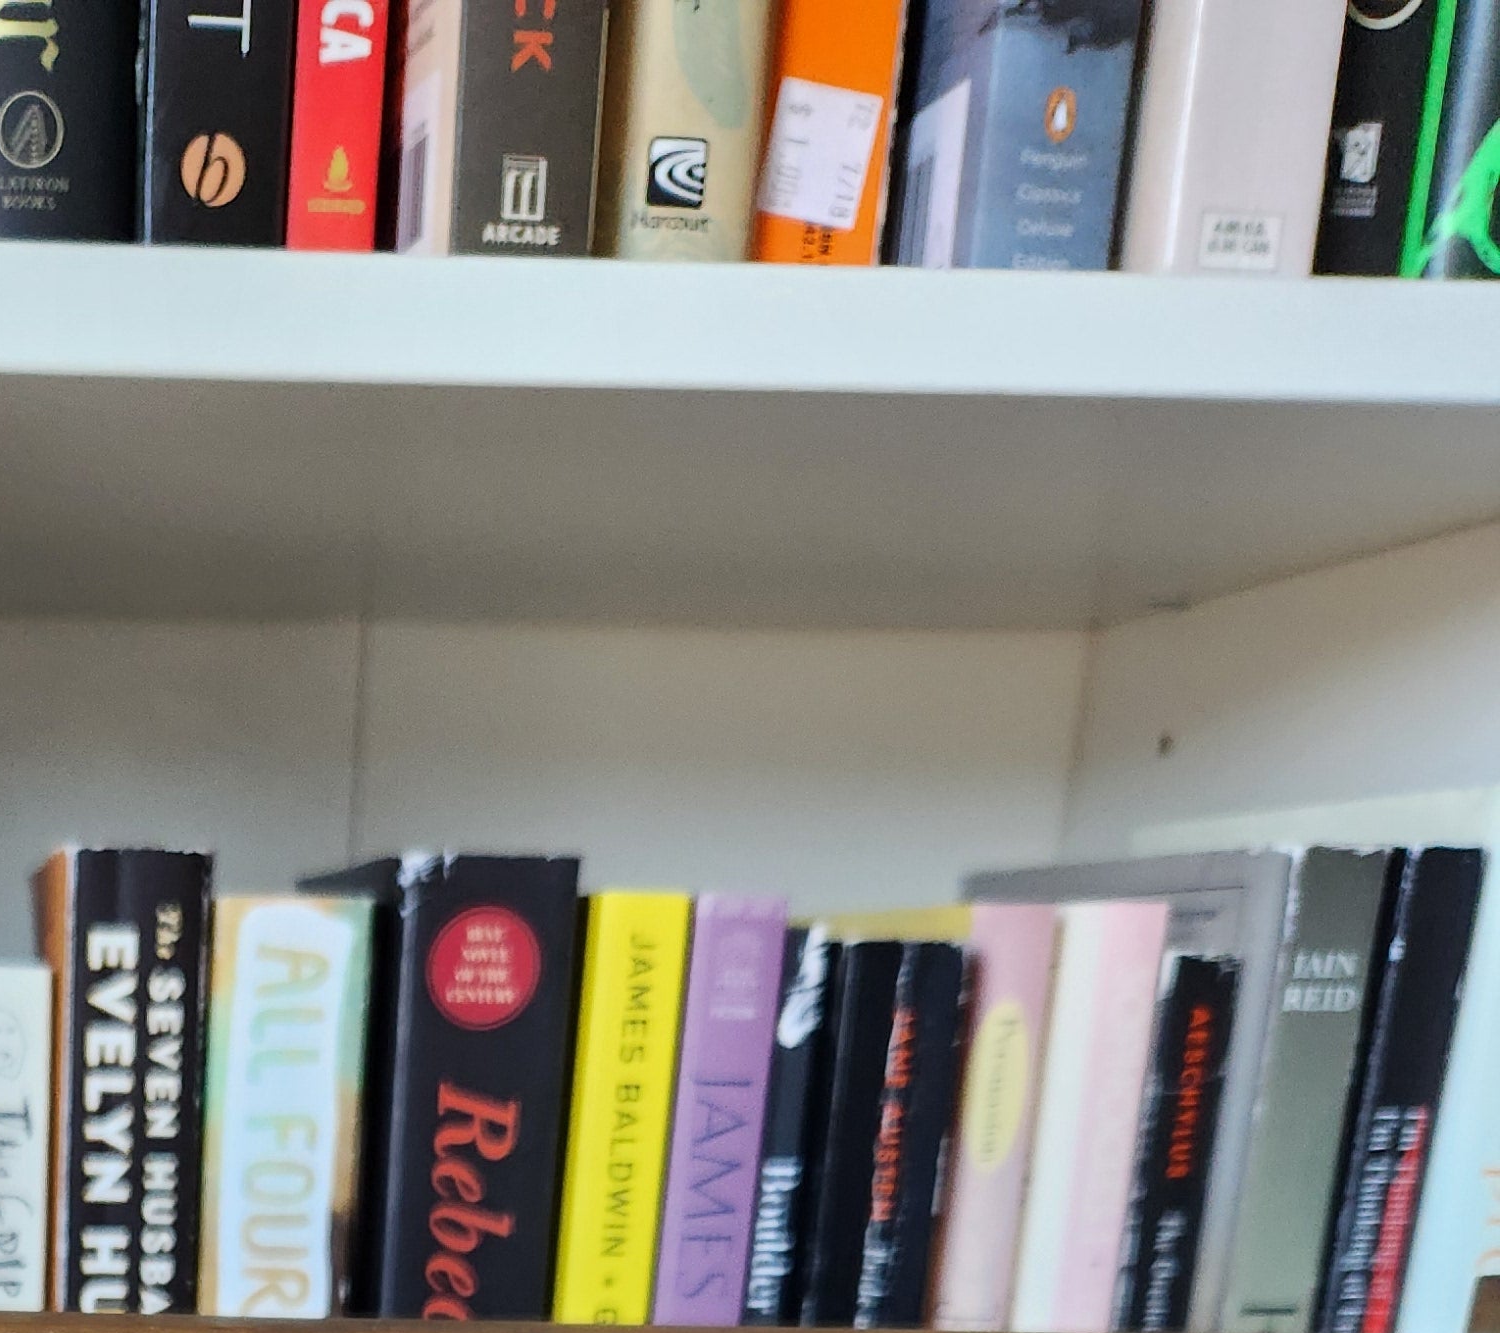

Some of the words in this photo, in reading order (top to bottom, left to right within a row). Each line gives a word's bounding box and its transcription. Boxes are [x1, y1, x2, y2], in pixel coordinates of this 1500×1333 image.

[481, 223, 562, 247] ARCADE
[82, 922, 142, 1206] EVELYN
[143, 965, 187, 1140] SEVEN
[246, 944, 331, 1083] ALL
[618, 932, 660, 1066] JAMES
[600, 1082, 645, 1260] BALDWIN
